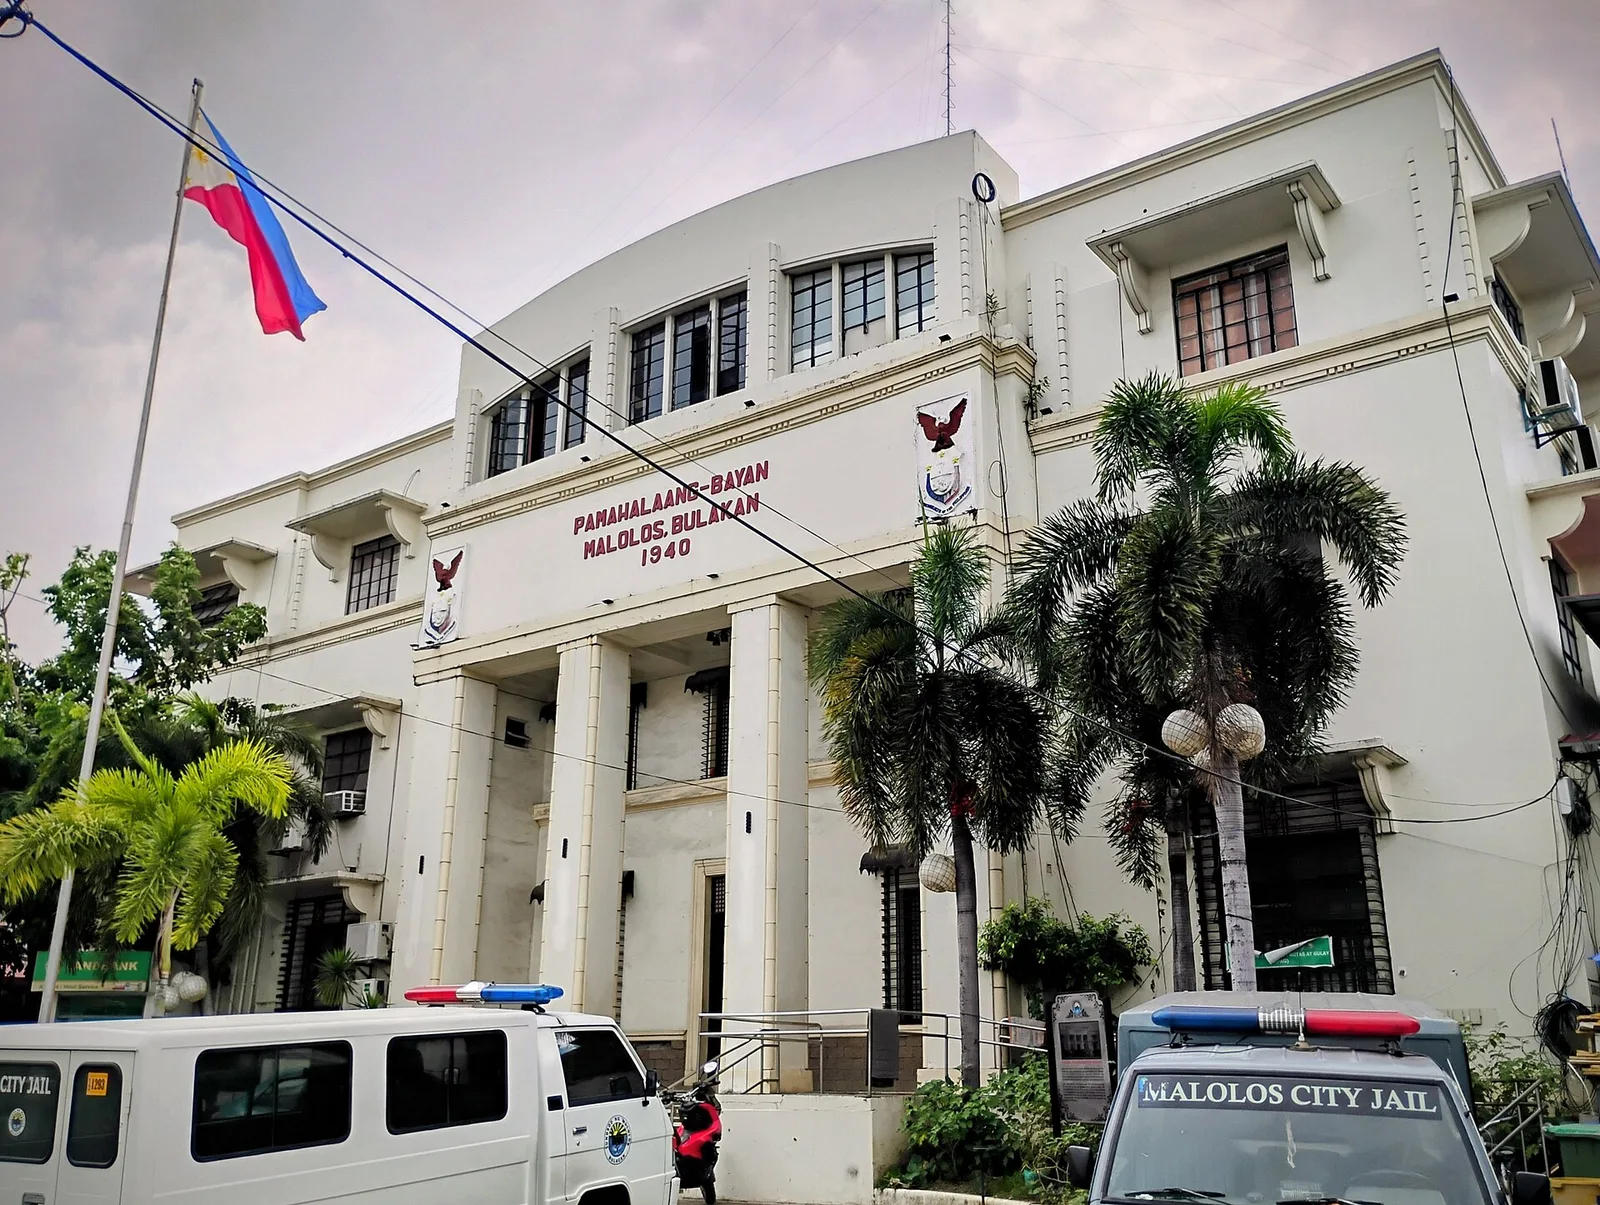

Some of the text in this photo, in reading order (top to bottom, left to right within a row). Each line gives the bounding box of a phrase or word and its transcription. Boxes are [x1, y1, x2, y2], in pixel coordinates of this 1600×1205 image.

[574, 461, 769, 535] PAMAHALAANG-BAYAN
[671, 493, 759, 535] BULAKAN
[641, 538, 691, 566] 1940
[0, 1075, 51, 1095] CITY JAIL
[91, 1078, 106, 1091] 1293
[1142, 1081, 1437, 1113] MALOLOS CITY JAIL
